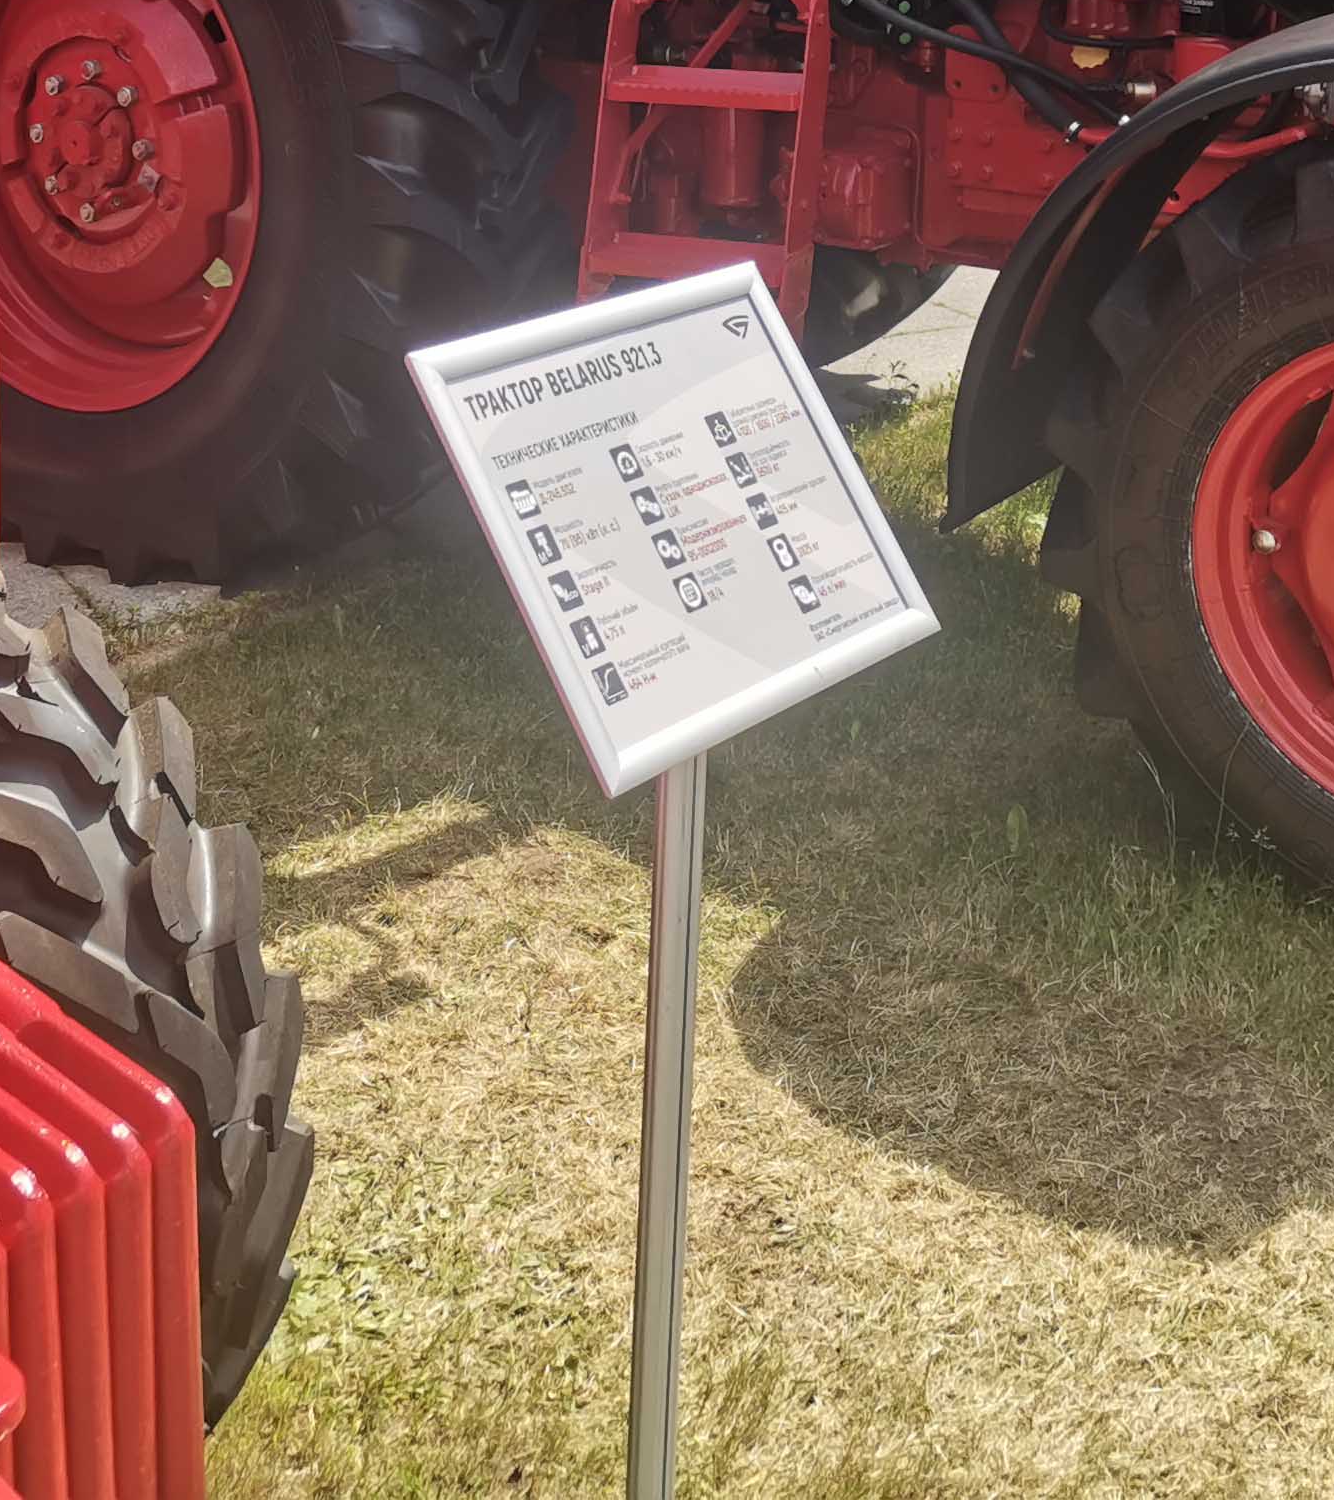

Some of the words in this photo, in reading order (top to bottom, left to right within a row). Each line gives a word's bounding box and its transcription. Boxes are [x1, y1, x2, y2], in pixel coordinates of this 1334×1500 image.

[464, 376, 547, 421] ТРАКТОР
[545, 354, 622, 396] BELARUS
[620, 343, 662, 373] 921.3
[492, 438, 559, 470] ТЕХНИЧЕСКИЕ
[559, 412, 638, 448] ХАРАКТЕРИСТИКИ
[582, 580, 603, 597] Stage
